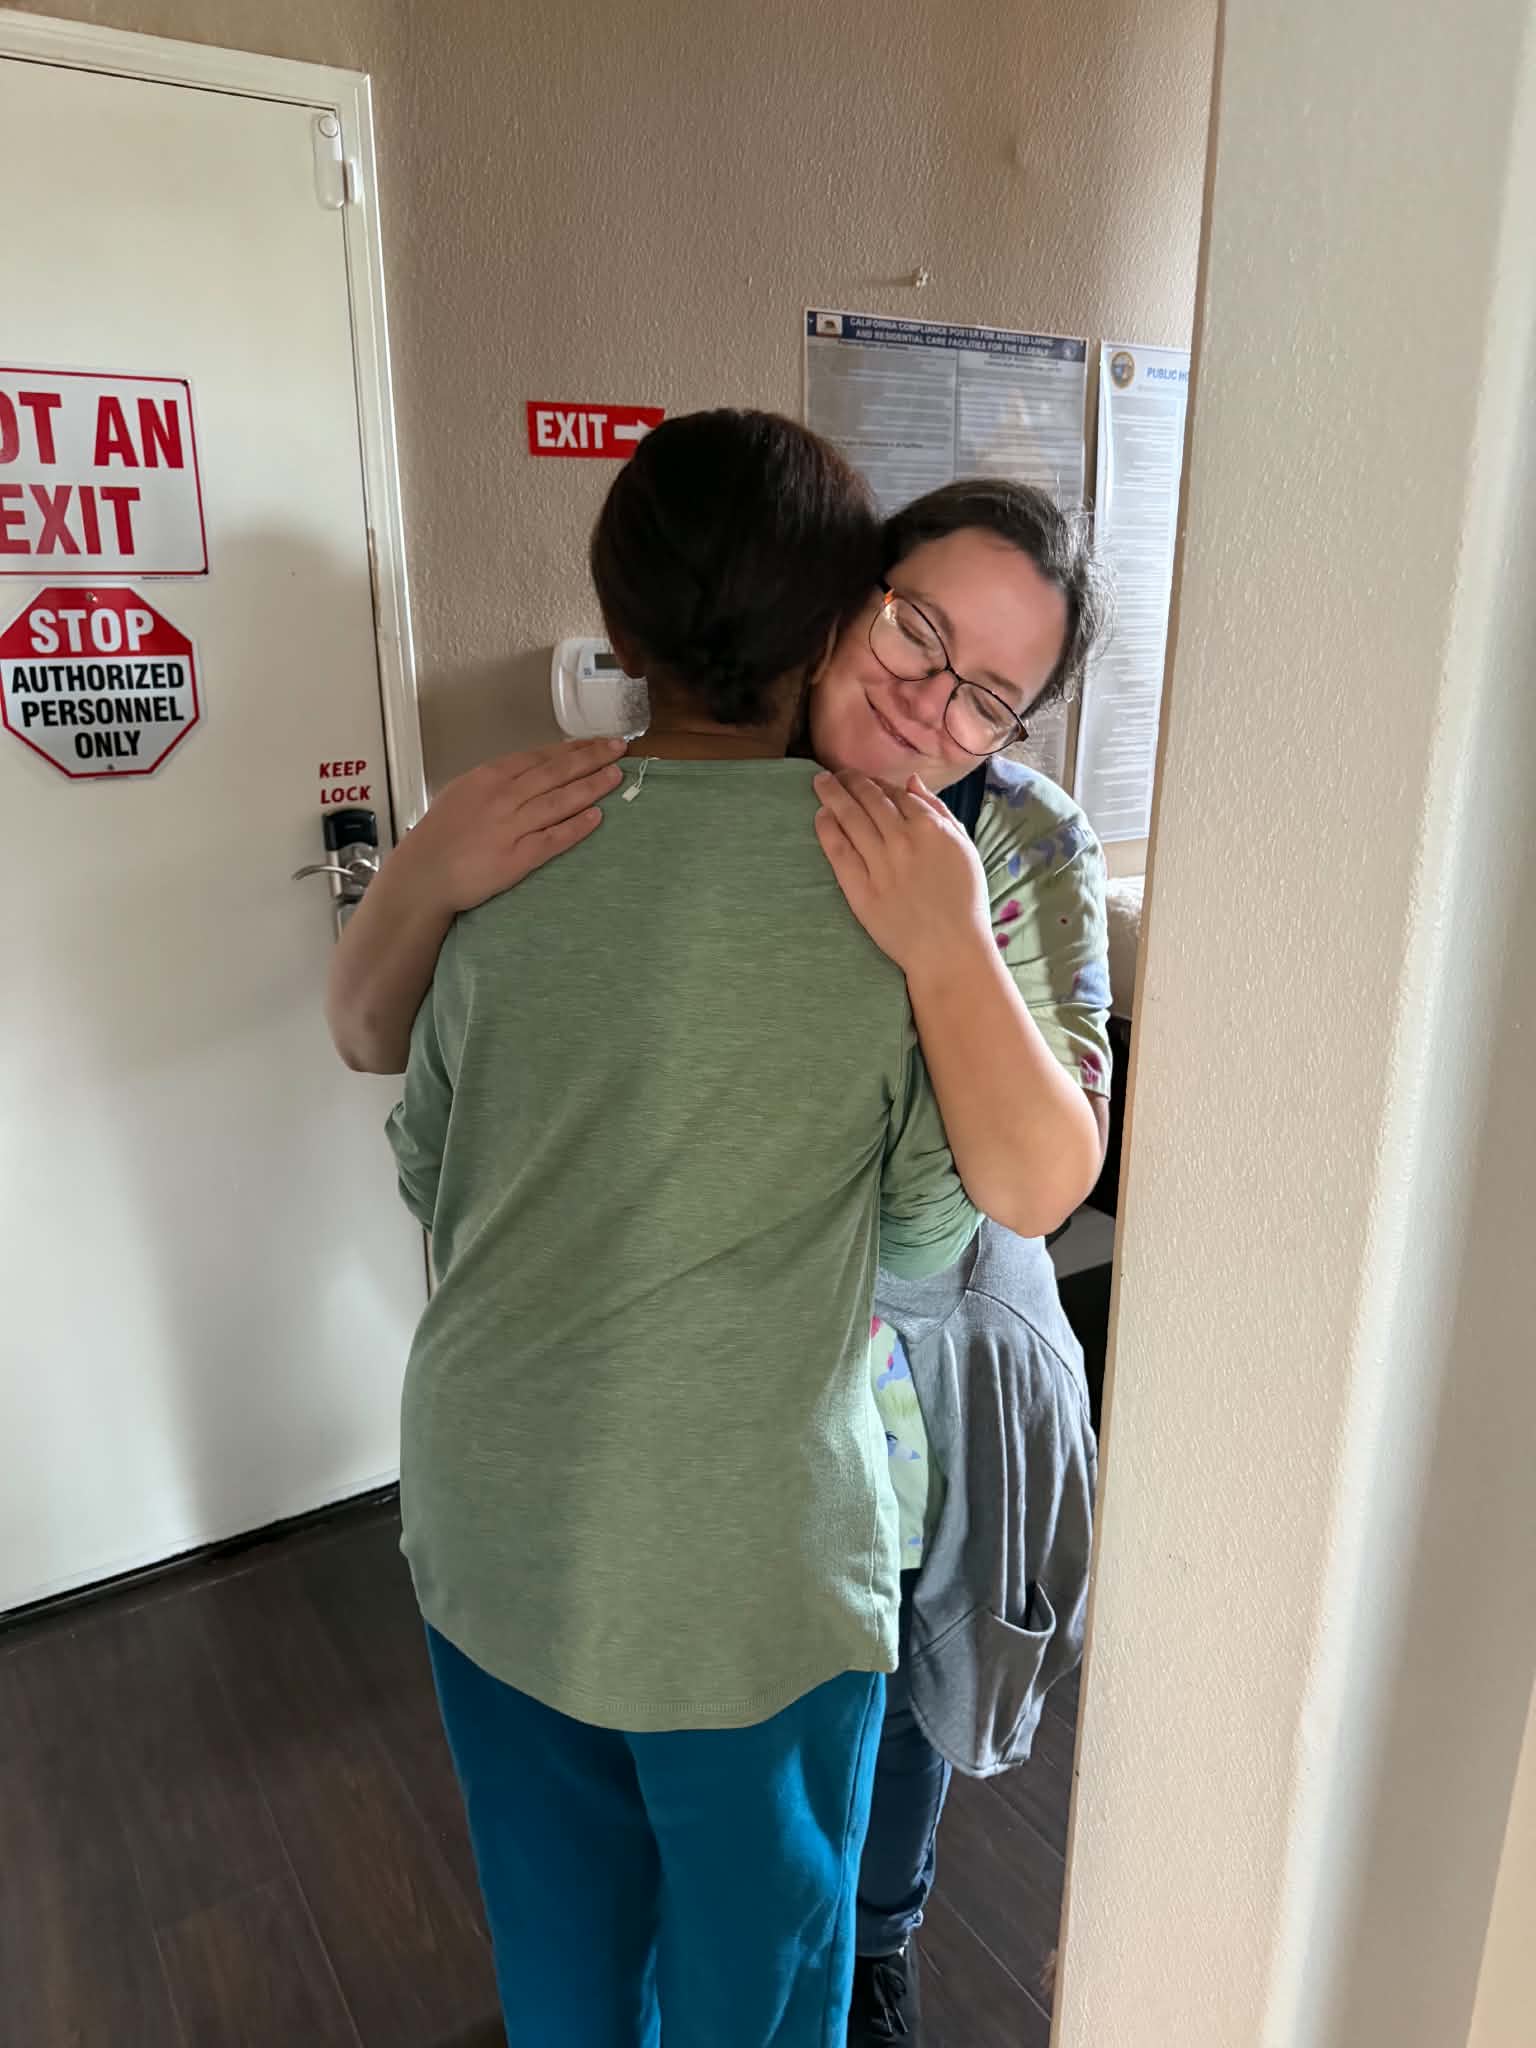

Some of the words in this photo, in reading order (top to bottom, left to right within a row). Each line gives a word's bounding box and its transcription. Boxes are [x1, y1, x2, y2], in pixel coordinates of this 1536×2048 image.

[1147, 367, 1177, 380] PUBLIC
[94, 396, 184, 468] AN
[536, 411, 608, 448] EXIT
[0, 484, 140, 555] EXIT
[29, 608, 154, 653] STOP
[12, 663, 184, 694] AUTHORIZED
[21, 696, 184, 727] PERSONNEL
[74, 730, 141, 759] ONLY
[319, 760, 367, 779] KEEP
[320, 785, 371, 804] LOCK
